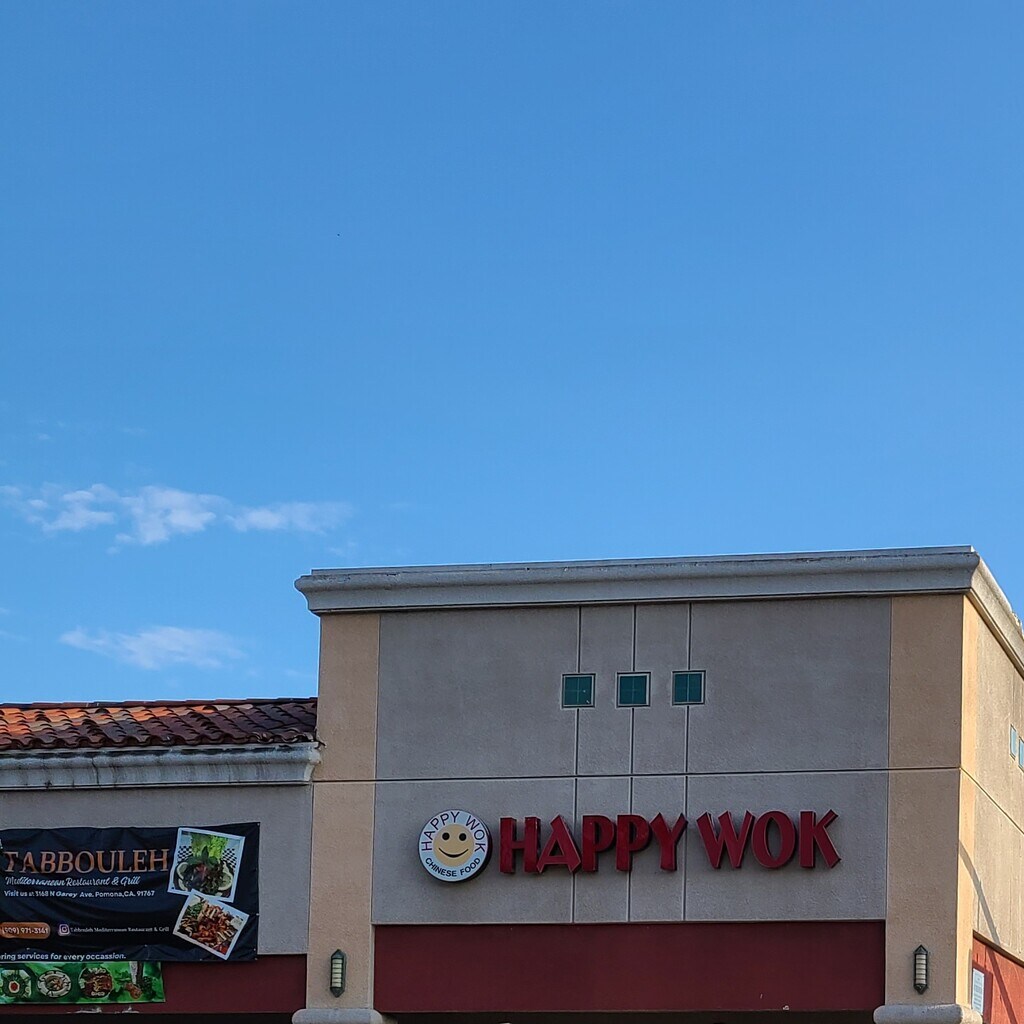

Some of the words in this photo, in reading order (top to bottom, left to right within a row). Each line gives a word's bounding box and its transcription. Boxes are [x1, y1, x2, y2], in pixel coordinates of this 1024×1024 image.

[421, 811, 460, 851] HAPPY
[465, 815, 486, 853] WOK
[499, 812, 689, 874] HAPPY
[696, 809, 843, 869] WOK
[4, 849, 170, 873] TABBOULEH
[425, 857, 458, 877] CHINESE
[459, 857, 481, 876] FOOD
[66, 876, 111, 887] Restaurant
[111, 876, 119, 886] &
[120, 876, 141, 887] Grill
[56, 891, 78, 899] Garey
[0, 952, 16, 961] ring
[17, 952, 49, 960] services
[50, 952, 62, 960] for
[63, 953, 85, 962] every
